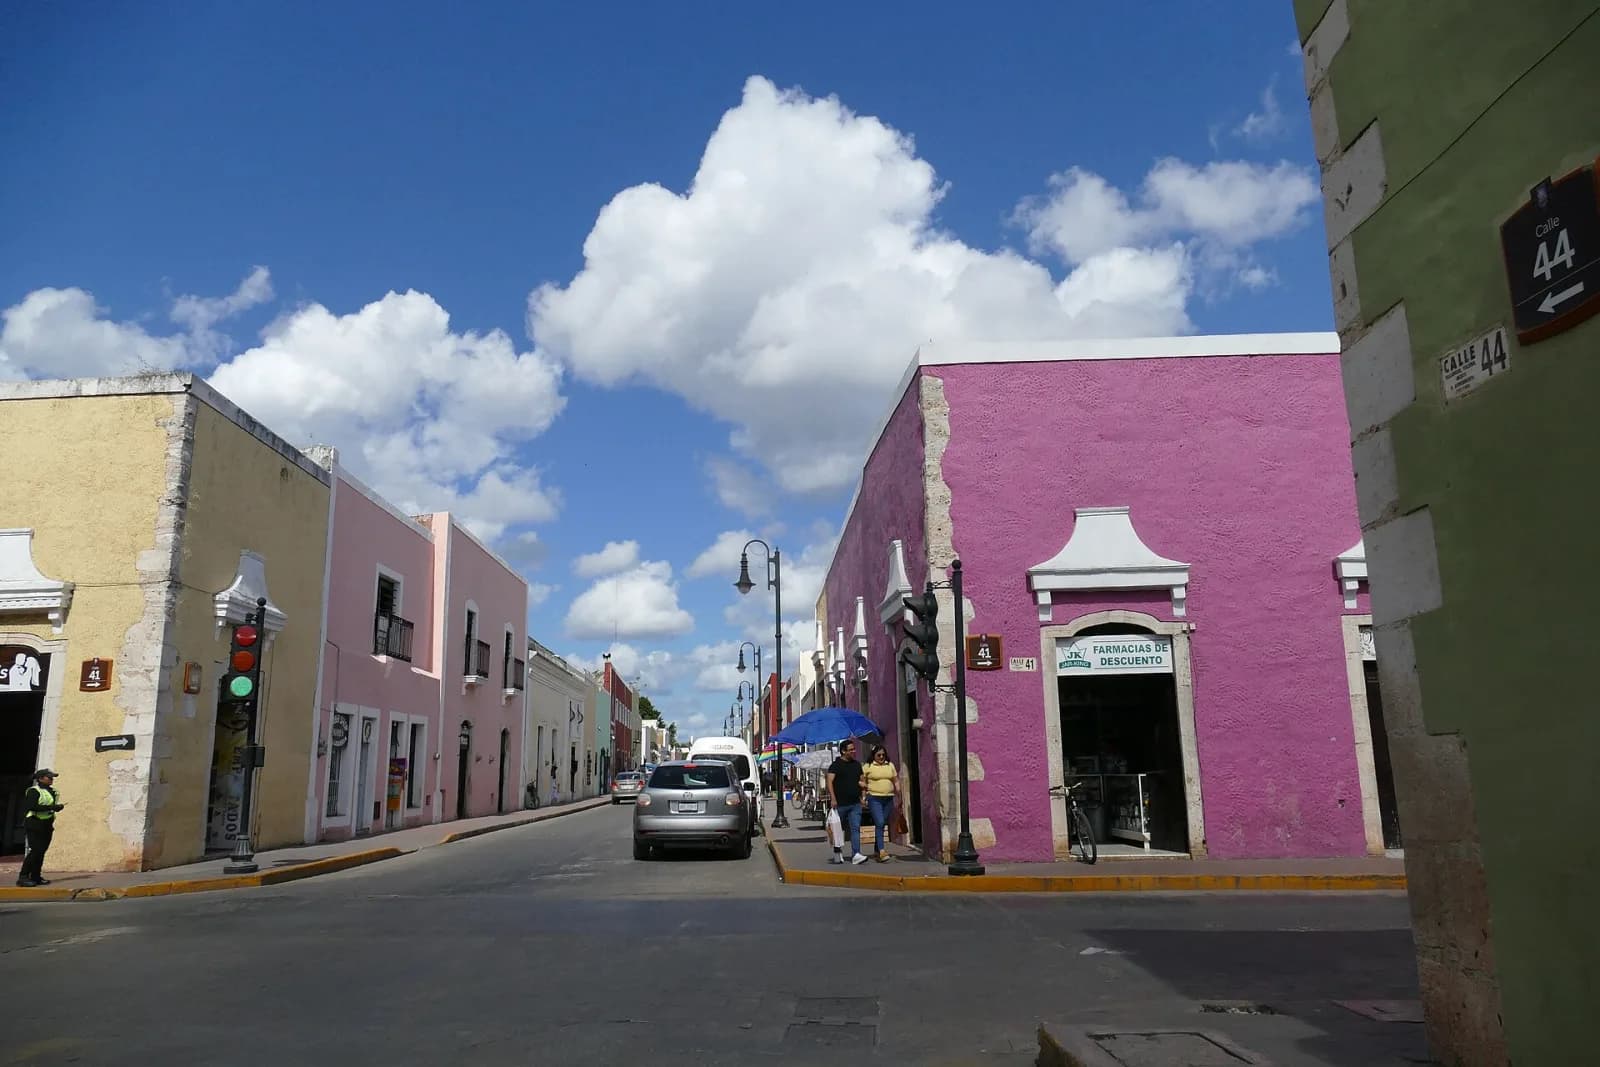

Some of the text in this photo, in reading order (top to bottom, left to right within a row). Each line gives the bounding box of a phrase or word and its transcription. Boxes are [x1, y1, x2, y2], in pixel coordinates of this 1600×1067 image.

[1536, 216, 1560, 238] Calle
[1533, 228, 1576, 280] 44
[1443, 330, 1507, 377] CALLE 44
[978, 647, 992, 659] 41
[1093, 643, 1169, 655] FARMACIAS DE
[1067, 651, 1083, 660] JK
[1100, 655, 1163, 666] DESCUENTO
[1025, 658, 1034, 670] 41
[88, 670, 101, 681] 41
[224, 802, 241, 841] ADOS
